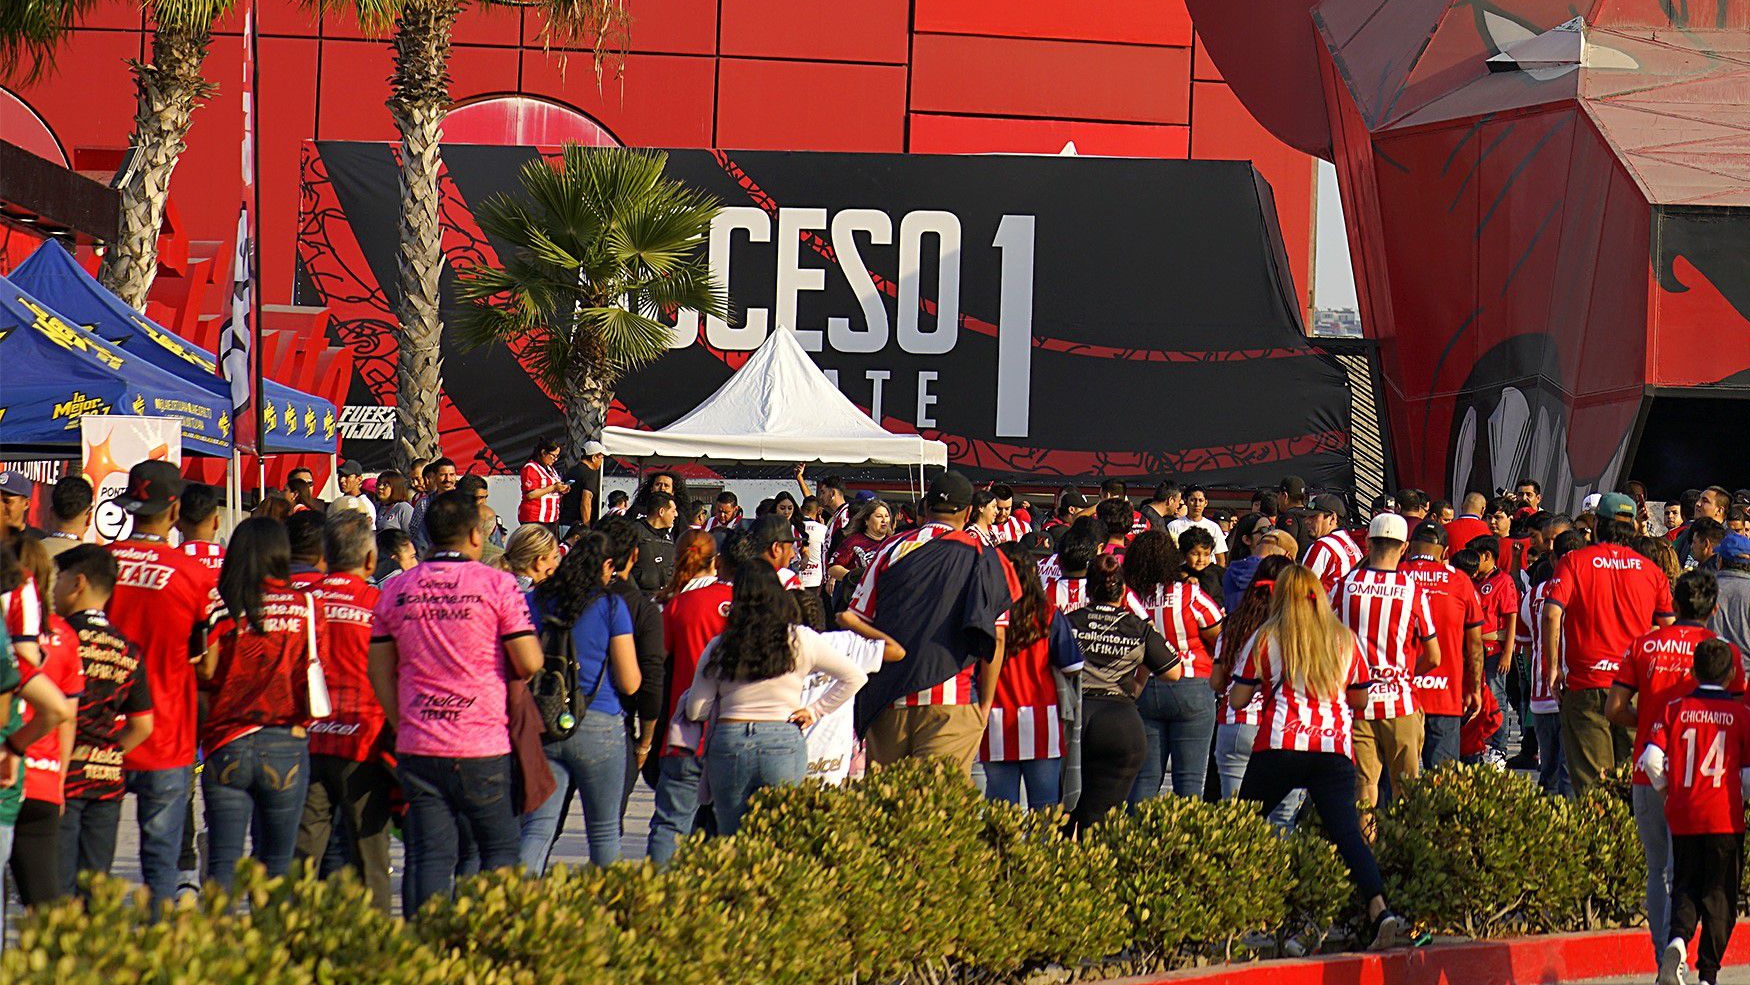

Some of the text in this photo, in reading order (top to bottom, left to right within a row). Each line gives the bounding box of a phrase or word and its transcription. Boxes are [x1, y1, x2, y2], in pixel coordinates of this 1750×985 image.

[991, 214, 1036, 437] 1
[1592, 556, 1642, 570] OMNILIFE
[1347, 582, 1406, 599] OMNILIFE
[1088, 643, 1131, 656] AFIRME
[1680, 710, 1734, 726] CHICHARITO
[1681, 728, 1727, 788] 14
